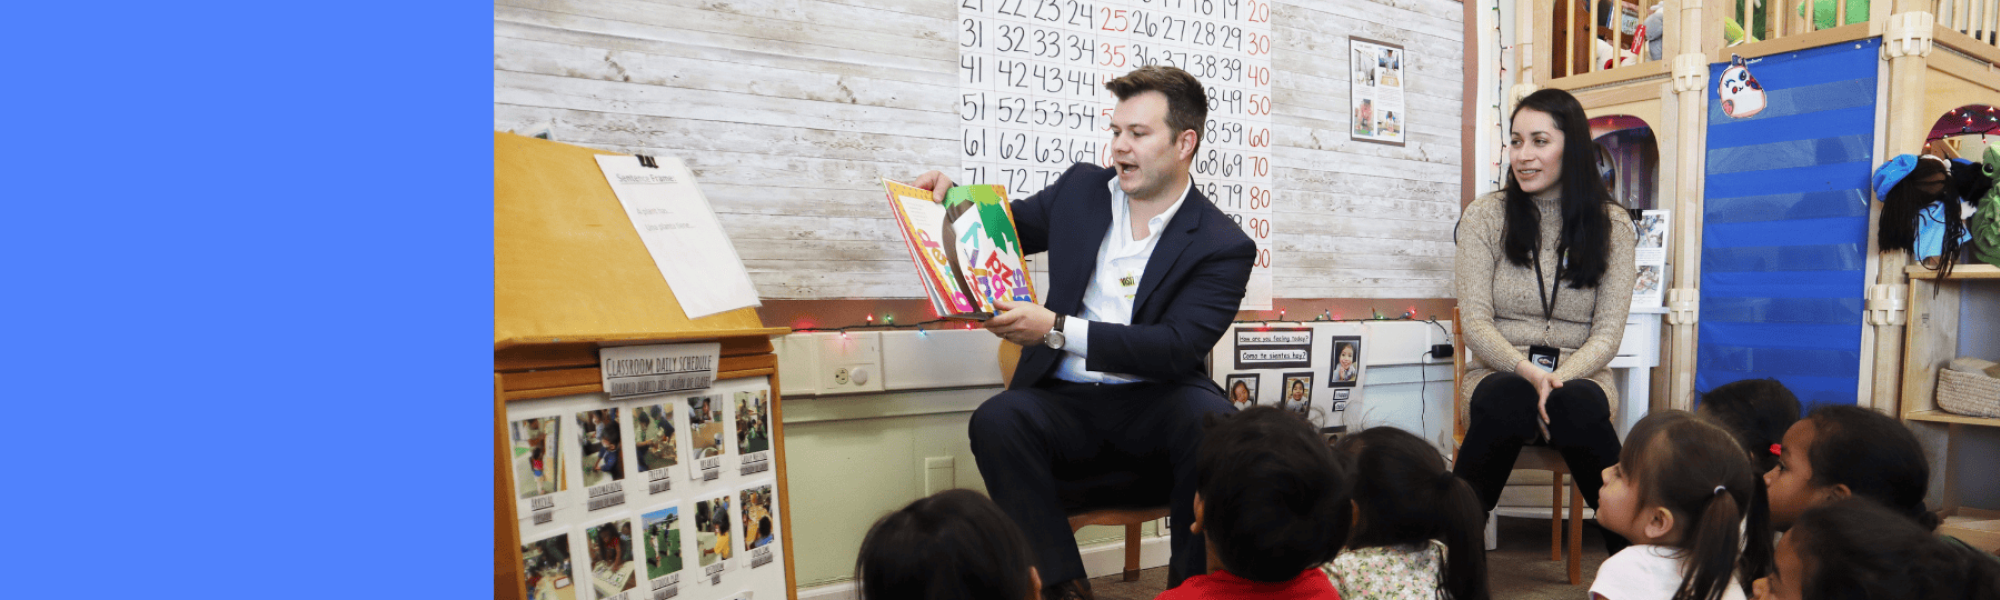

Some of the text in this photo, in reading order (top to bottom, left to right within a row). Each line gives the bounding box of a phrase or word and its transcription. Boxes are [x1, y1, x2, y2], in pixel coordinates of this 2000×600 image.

[1033, 0, 1061, 21] 23
[1066, 0, 1093, 29] 24
[1100, 7, 1128, 32] 25
[1132, 10, 1158, 37] 26
[1162, 15, 1186, 41] 27
[1192, 20, 1216, 46] 28
[1220, 25, 1242, 51] 29
[1247, 32, 1270, 55] 30
[1247, 0, 1270, 22] 20
[961, 18, 983, 48] 31
[996, 24, 1029, 53] 32
[1033, 29, 1061, 58] 33
[1066, 34, 1095, 64] 34
[1099, 42, 1126, 68] 35
[1192, 54, 1217, 79] 38
[1220, 57, 1242, 83] 39
[1247, 64, 1270, 87] 40
[960, 55, 982, 83] 41
[998, 60, 1029, 88] 42
[1033, 64, 1064, 93] 43
[1067, 69, 1095, 96] 44
[1222, 88, 1243, 114] 49
[1247, 93, 1271, 116] 50
[961, 92, 985, 121] 51
[998, 97, 1028, 124] 52
[1034, 99, 1064, 127] 53
[1068, 103, 1095, 132] 54
[1221, 121, 1243, 145] 59
[1248, 126, 1270, 148] 60
[964, 128, 986, 157] 61
[1000, 132, 1028, 160] 62
[1034, 136, 1065, 163] 63
[1068, 138, 1096, 165] 64
[1195, 149, 1218, 176] 68
[1222, 152, 1243, 177] 69
[1247, 156, 1269, 177] 70
[965, 166, 985, 185] 71
[1001, 168, 1030, 194] 72
[1222, 183, 1243, 209] 79
[1250, 186, 1271, 210] 80
[1249, 217, 1270, 239] 90
